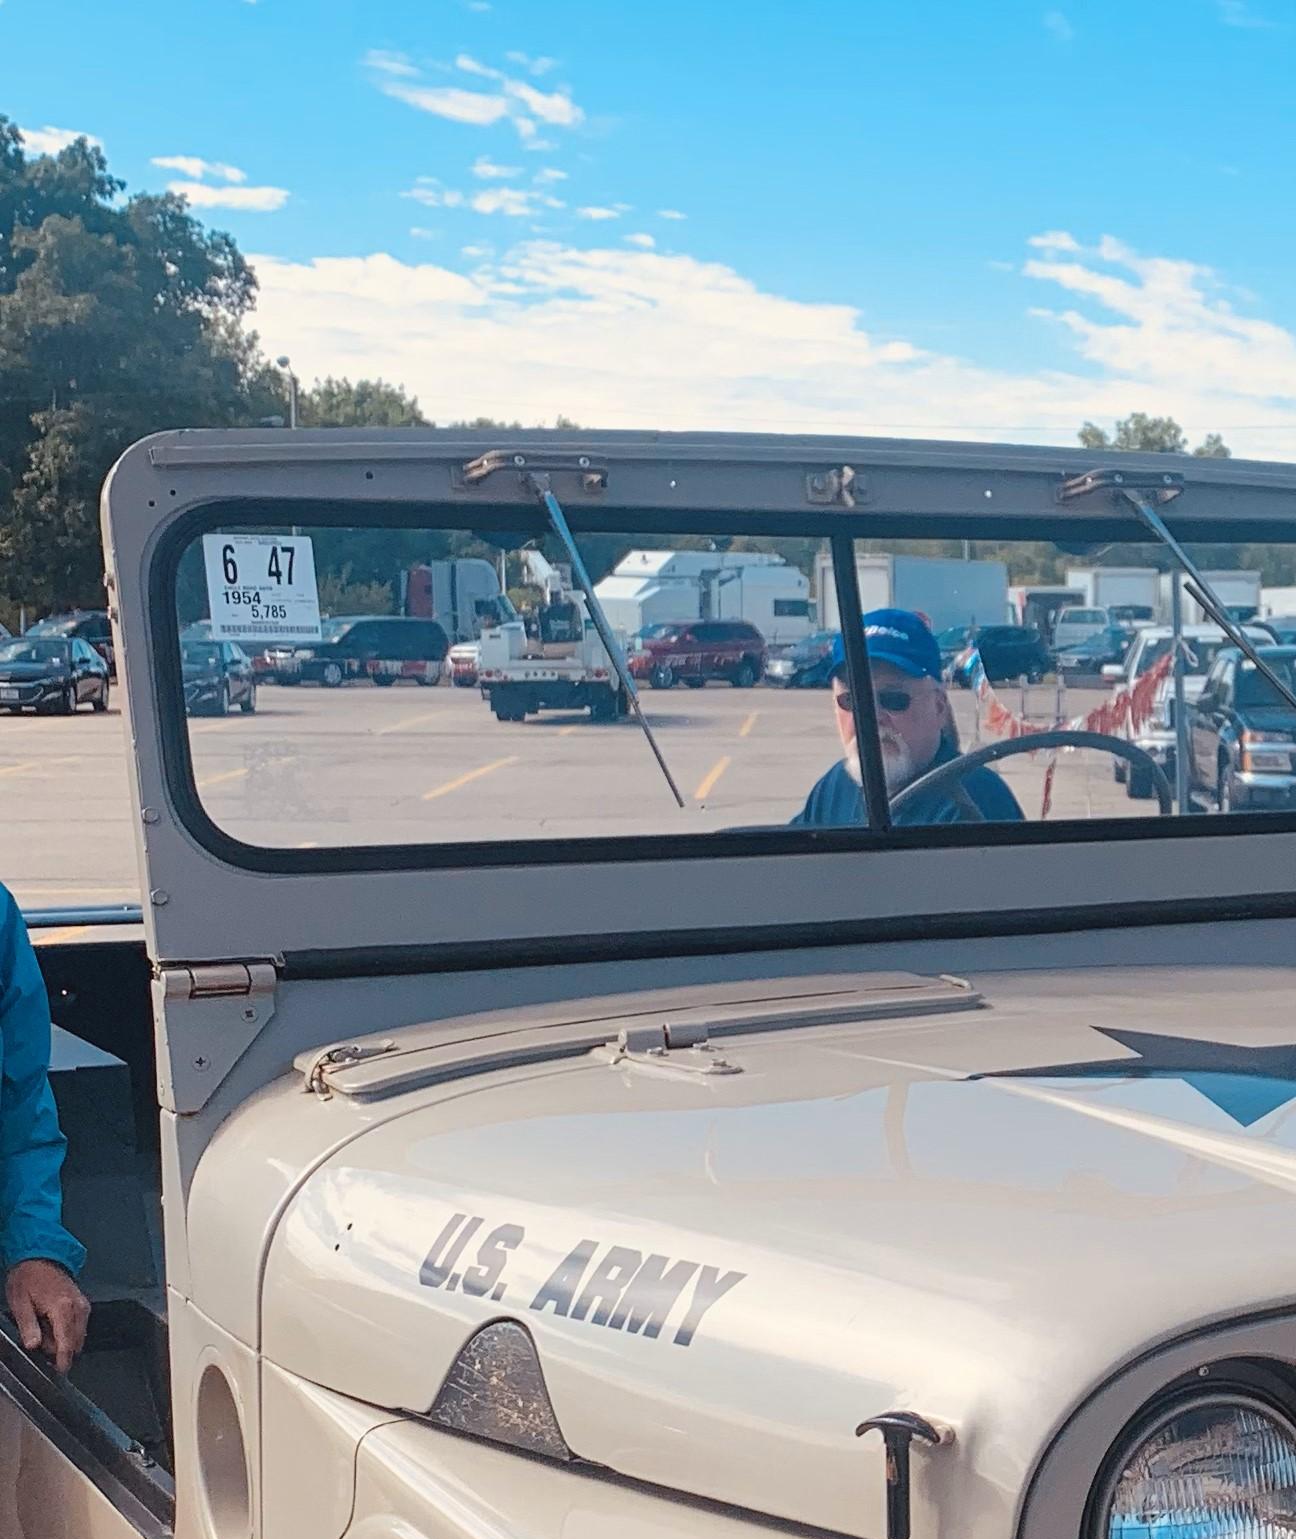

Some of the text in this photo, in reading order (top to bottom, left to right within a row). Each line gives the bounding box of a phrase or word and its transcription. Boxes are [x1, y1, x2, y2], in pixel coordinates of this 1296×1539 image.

[222, 544, 295, 585] 6 47
[222, 591, 262, 605] 1954
[251, 604, 287, 620] 5,785
[419, 1213, 748, 1347] U.S. ARMY
